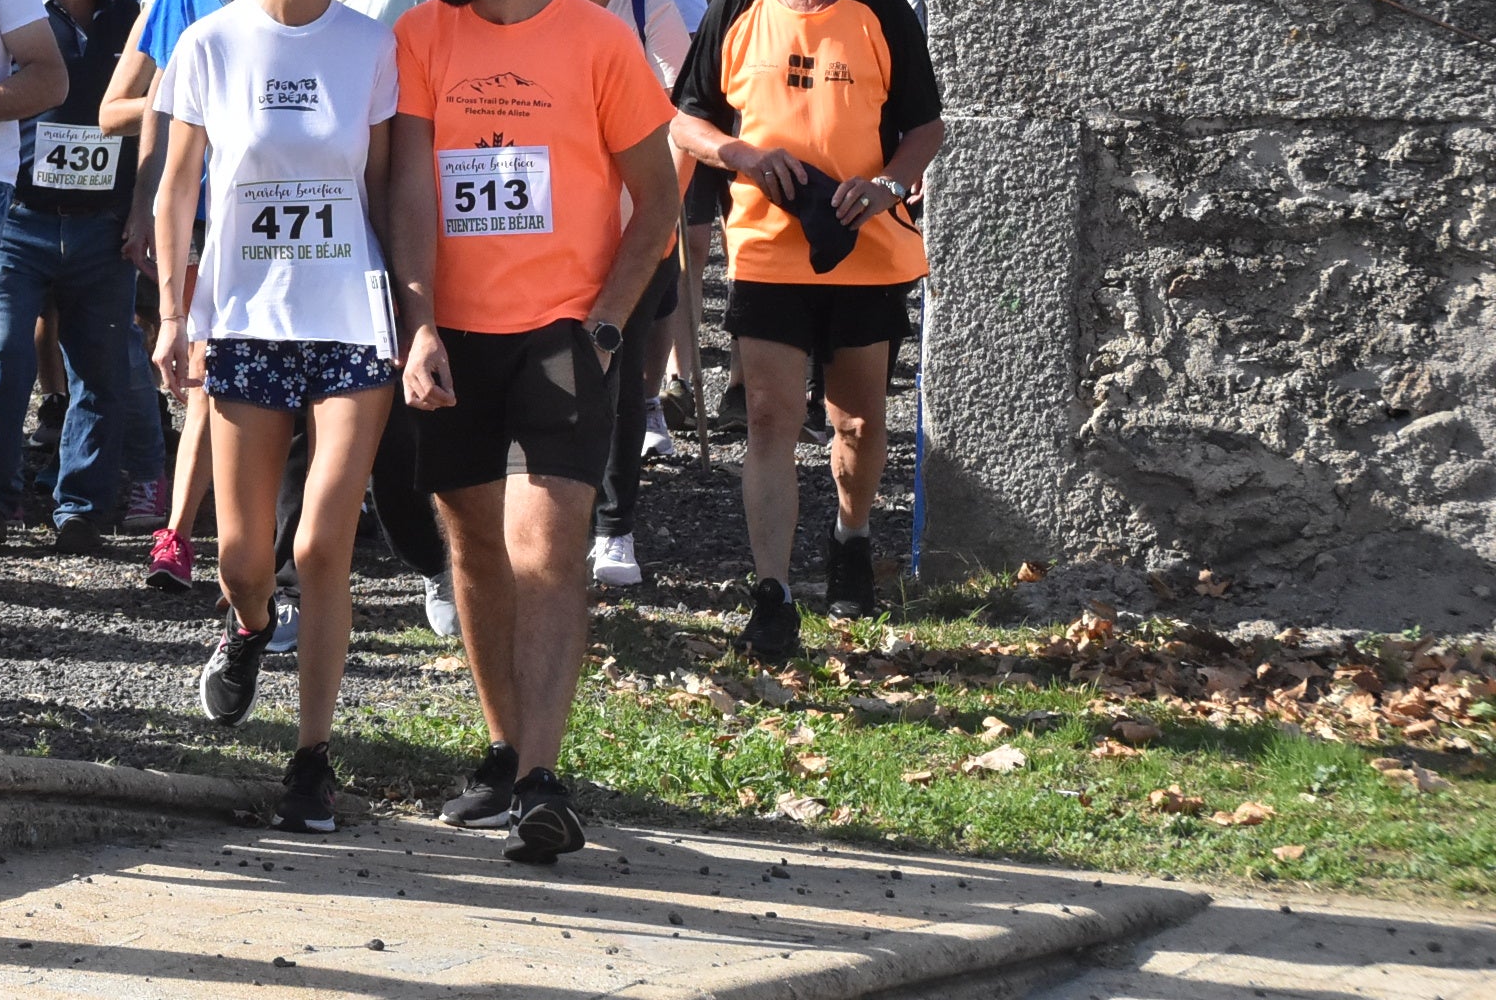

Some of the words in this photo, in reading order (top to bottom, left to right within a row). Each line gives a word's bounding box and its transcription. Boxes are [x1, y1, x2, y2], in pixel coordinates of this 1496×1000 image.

[266, 78, 318, 92] FUENTES
[258, 94, 274, 104] DE
[278, 91, 319, 105] BÉJAR
[446, 95, 455, 103] III
[456, 96, 478, 104] Cross
[479, 96, 498, 105] Trail
[532, 99, 552, 108] Mira
[465, 107, 495, 116] Flechas
[497, 107, 507, 116] de
[508, 108, 531, 117] Aliste
[44, 129, 78, 141] marcha
[46, 144, 109, 172] 430
[445, 157, 486, 175] marcha
[490, 156, 536, 173] benéfica
[36, 170, 76, 185] FUENTES
[76, 175, 89, 186] DE
[89, 173, 113, 186] BÉJAR
[244, 182, 292, 200] marcha
[295, 182, 344, 199] benéfica
[454, 179, 529, 213] 513
[251, 203, 334, 240] 471
[446, 217, 488, 234] FUENTES
[490, 216, 506, 231] DE
[508, 212, 545, 230] BÉJAR
[242, 244, 295, 260] FUENTES
[298, 245, 313, 259] DE
[315, 241, 352, 259] BÉJAR
